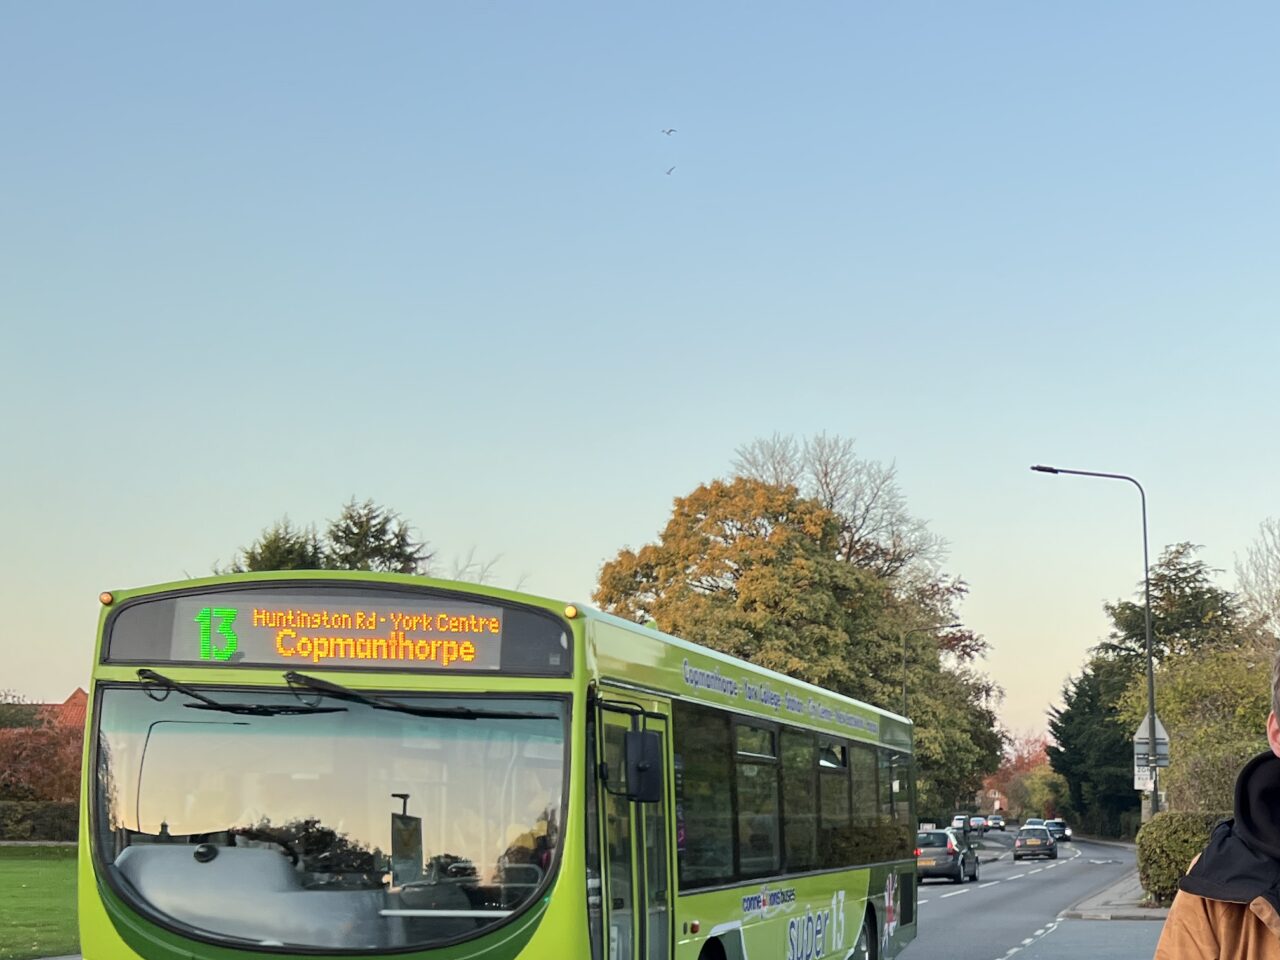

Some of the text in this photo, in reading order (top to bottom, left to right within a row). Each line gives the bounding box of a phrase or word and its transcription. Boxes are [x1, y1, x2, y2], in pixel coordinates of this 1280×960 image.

[194, 607, 239, 661] 13
[355, 611, 377, 630] Rd
[390, 612, 433, 631] York
[436, 613, 499, 633] Centre
[275, 628, 476, 667] Copmanthorpe
[831, 890, 845, 951] 13
